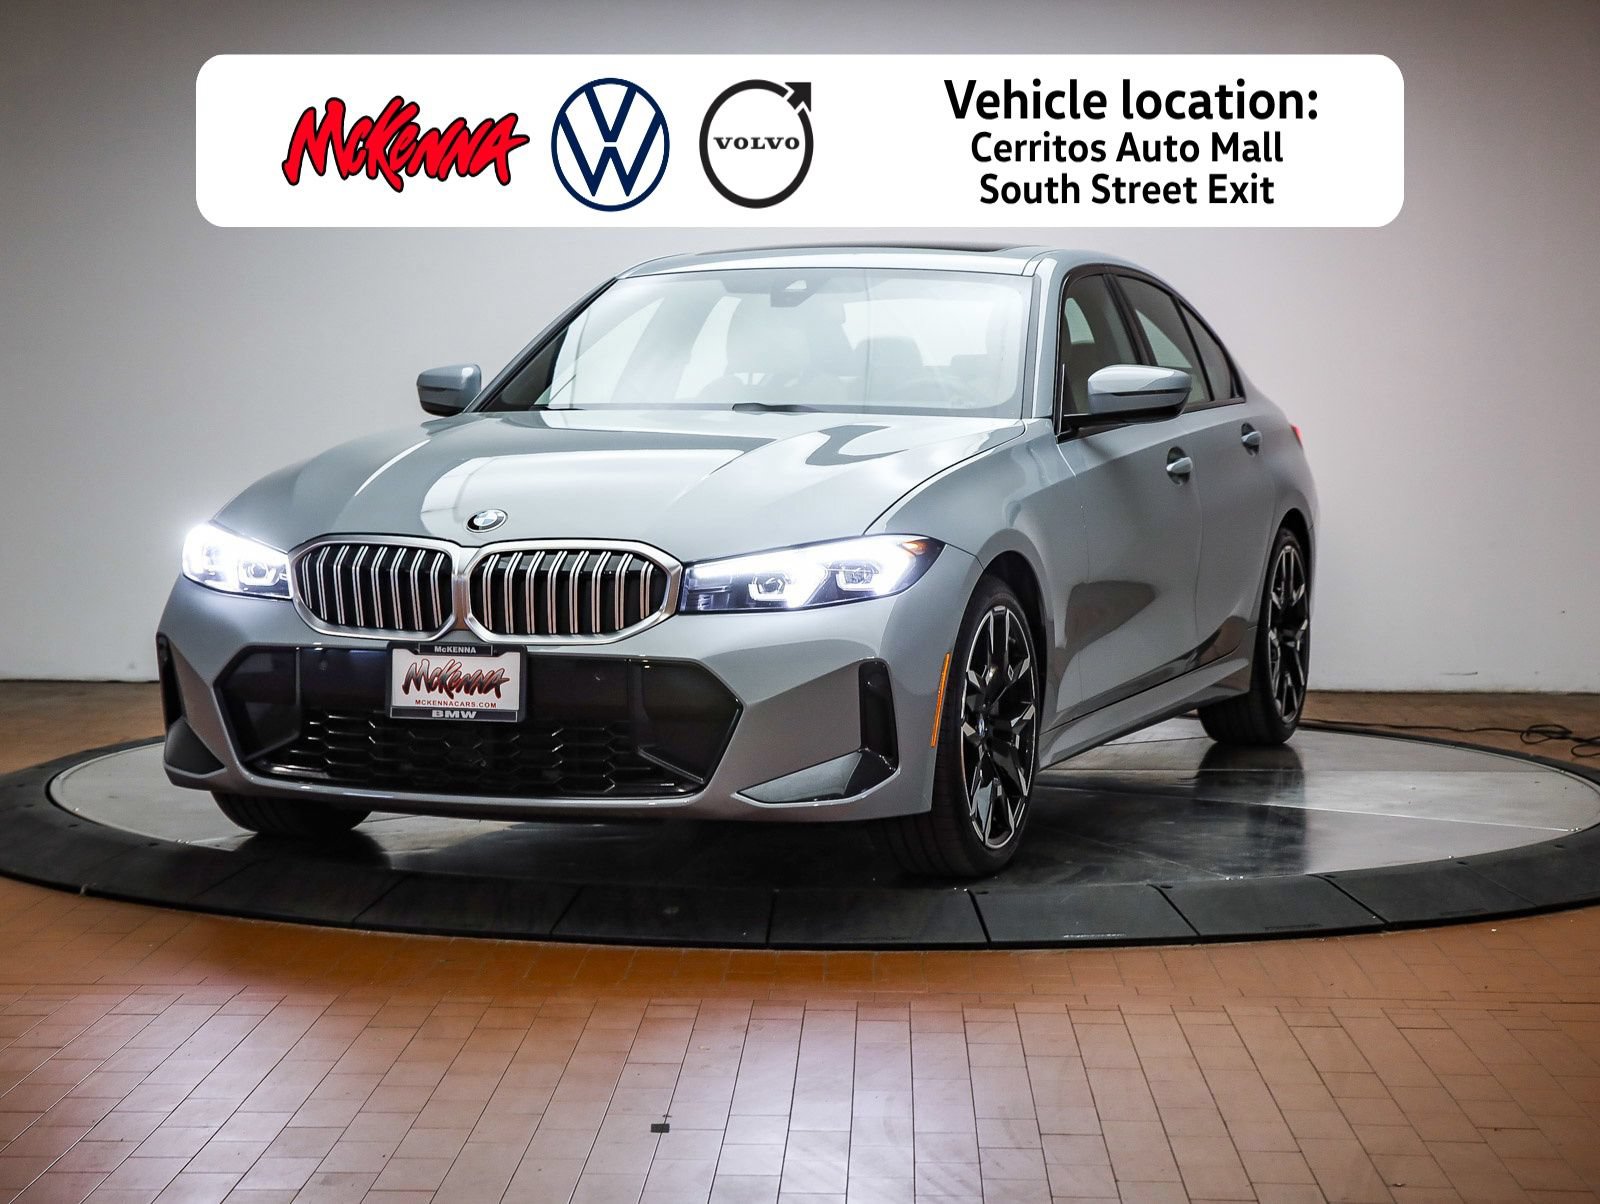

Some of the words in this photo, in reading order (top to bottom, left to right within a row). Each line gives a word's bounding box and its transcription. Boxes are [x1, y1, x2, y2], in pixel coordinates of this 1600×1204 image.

[434, 645, 476, 654] McKENNA
[415, 699, 497, 709] MCKENNACARS.COM
[431, 709, 477, 719] BMW
